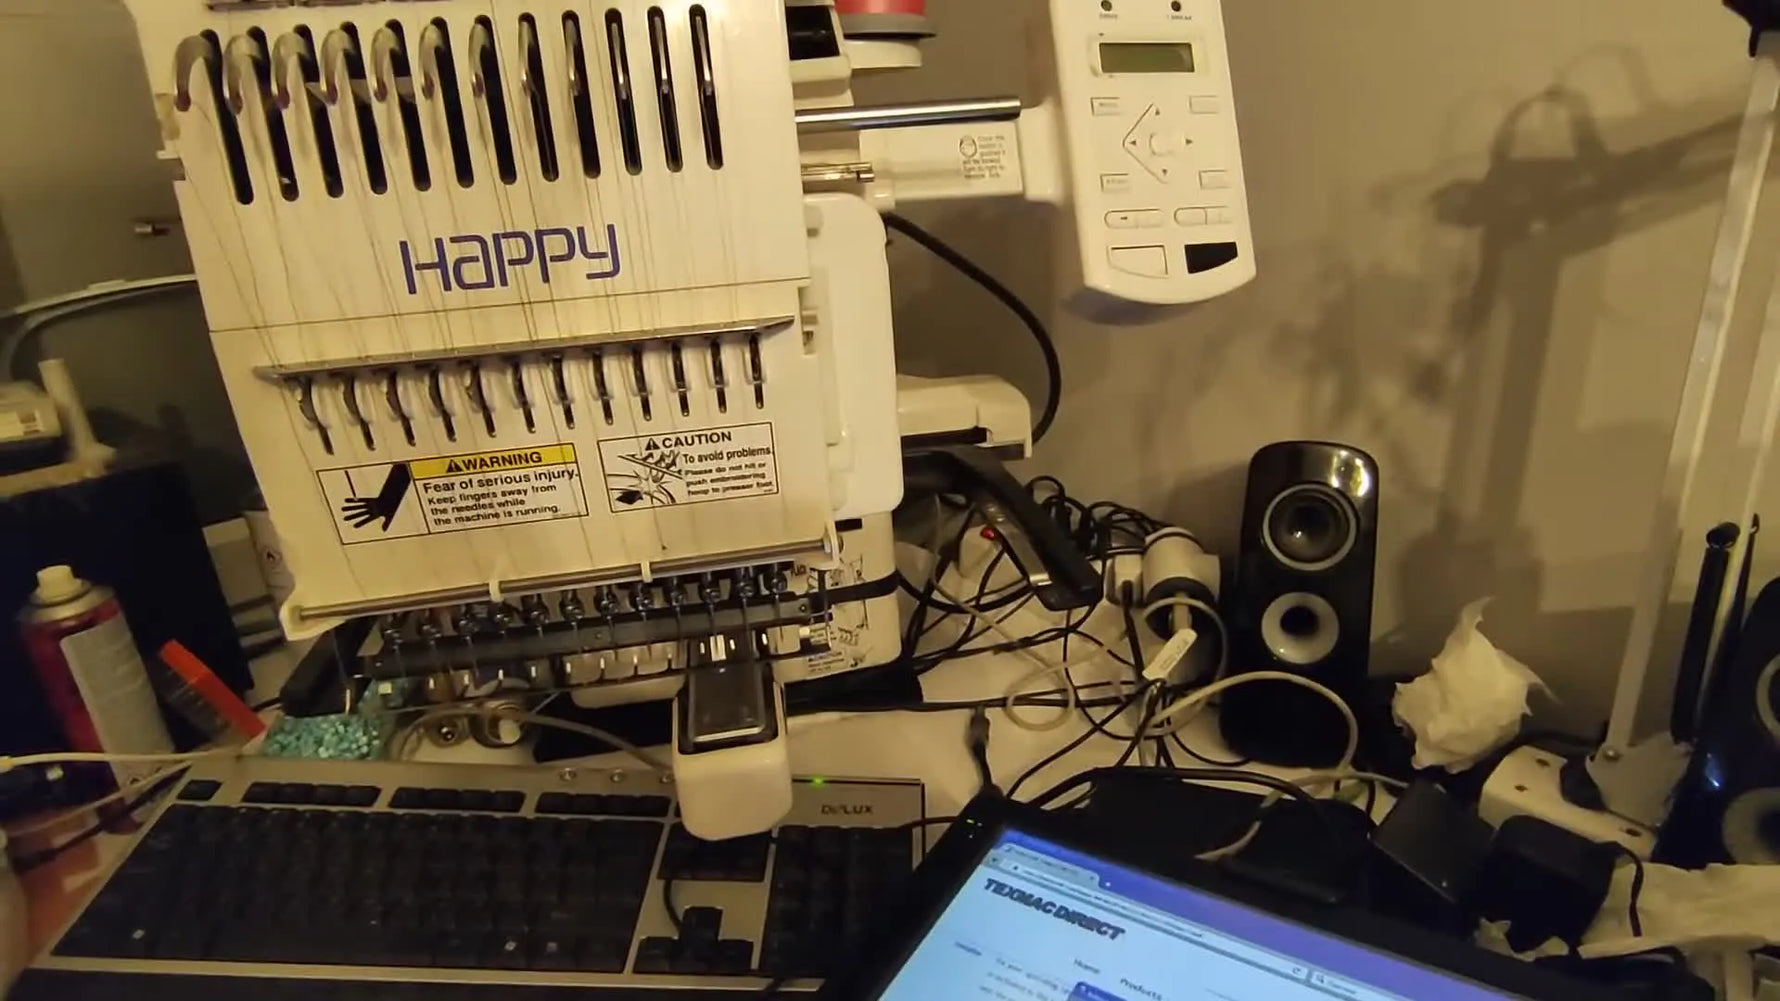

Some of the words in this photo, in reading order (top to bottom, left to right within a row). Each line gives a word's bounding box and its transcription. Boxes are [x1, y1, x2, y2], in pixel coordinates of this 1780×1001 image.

[661, 431, 732, 449] CAUTION
[462, 451, 543, 471] WARNING
[683, 453, 695, 464] To
[698, 450, 724, 462] avoid
[422, 481, 455, 494] Fear
[459, 478, 474, 490] of
[478, 470, 531, 488] serious
[534, 467, 579, 482] injury.
[428, 495, 457, 506] Keep
[459, 490, 498, 503] fingers
[501, 487, 528, 498] away
[531, 484, 557, 494] from
[431, 506, 448, 516] the
[451, 502, 495, 514] needles
[497, 498, 526, 509] while
[434, 517, 452, 526] the
[454, 511, 500, 523] machine
[503, 508, 513, 518] is
[516, 504, 561, 517] running.
[1053, 904, 1126, 940] DIRECT
